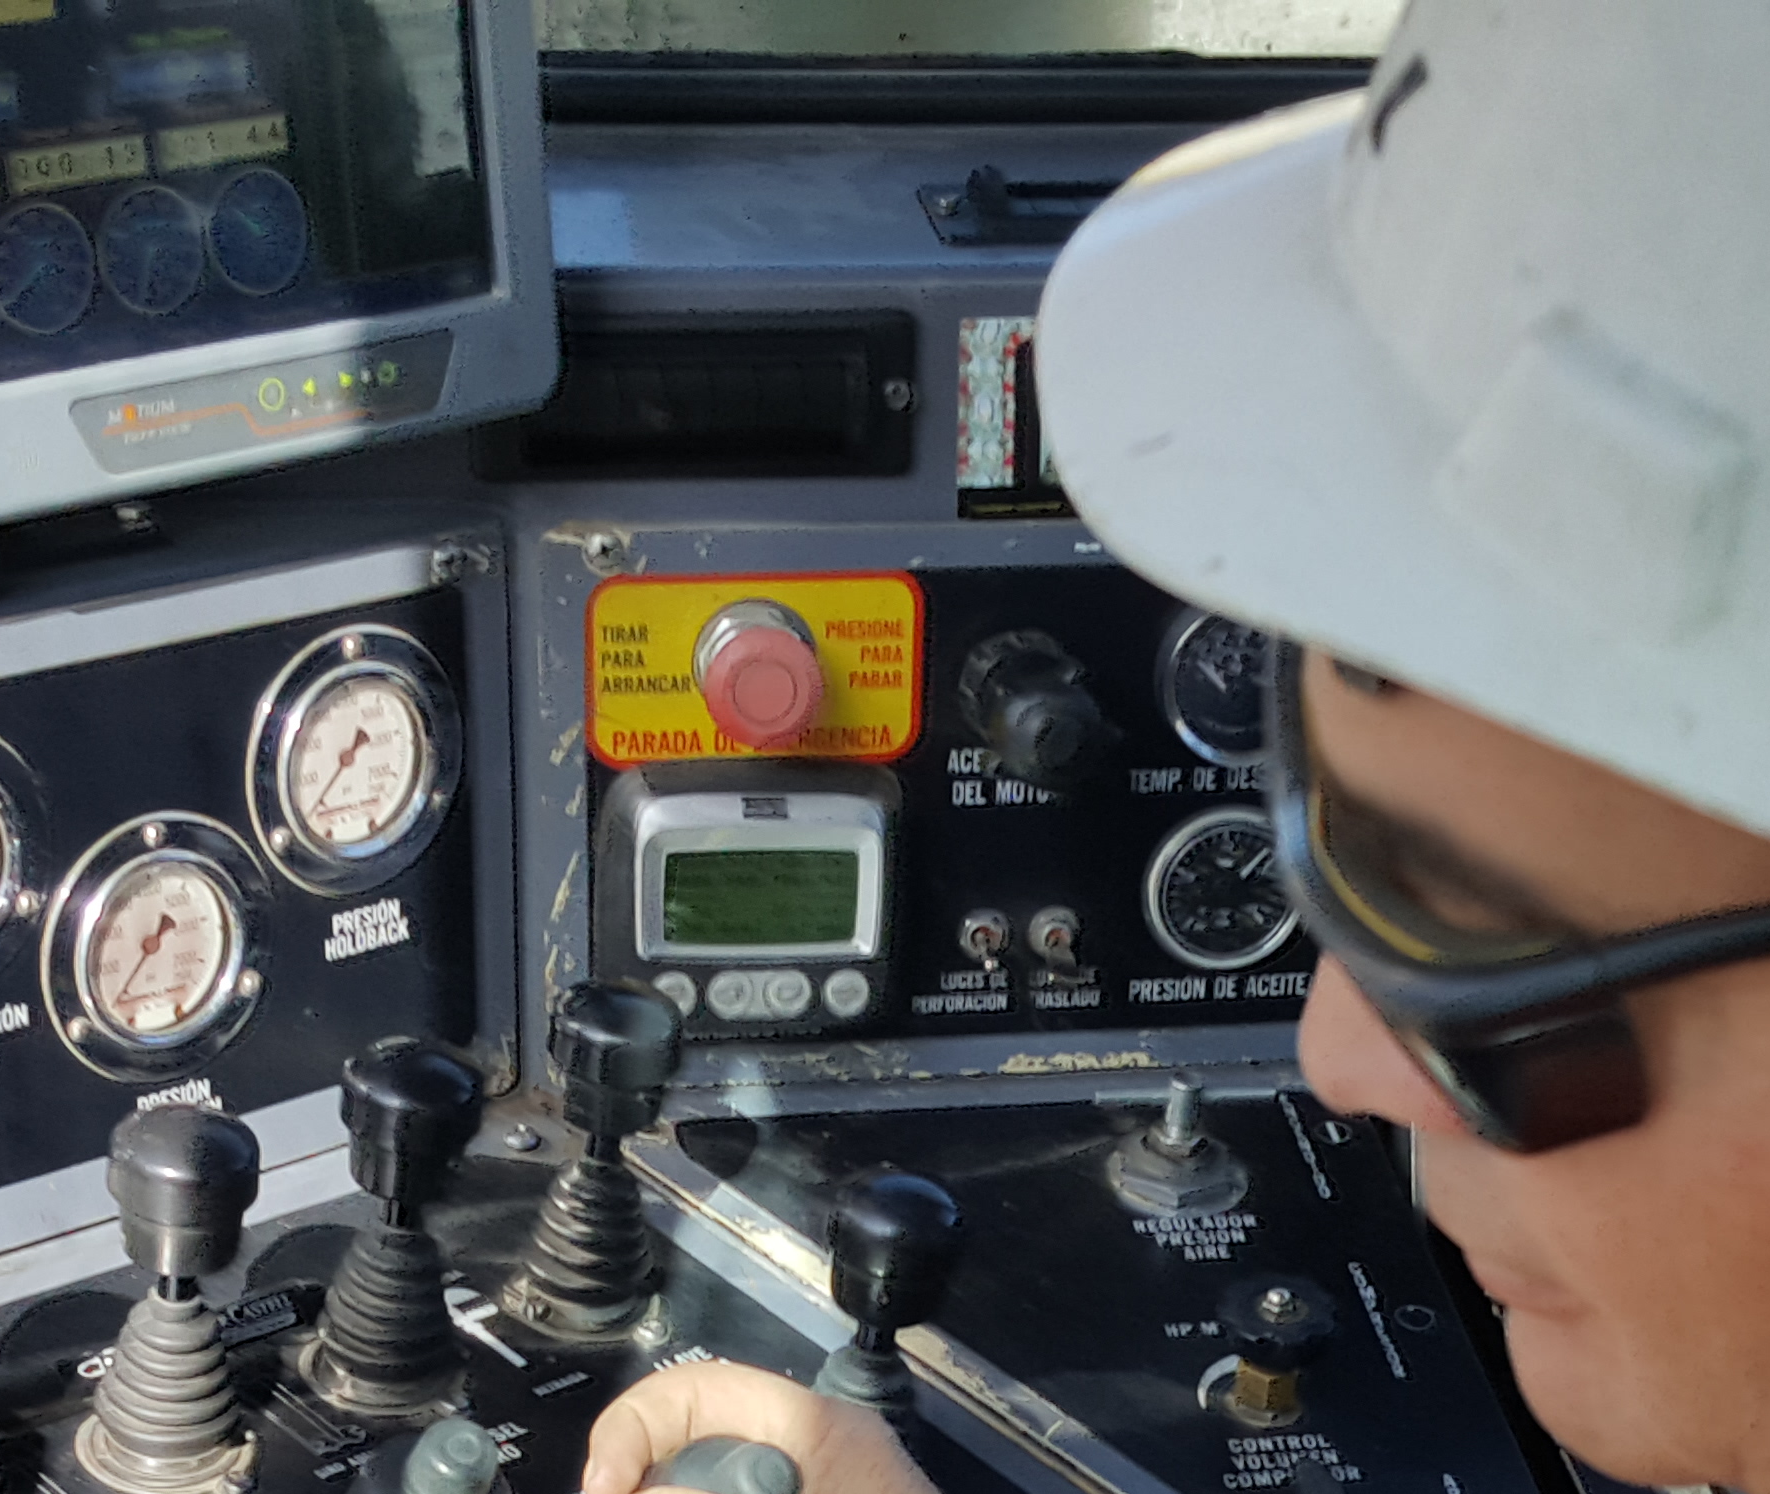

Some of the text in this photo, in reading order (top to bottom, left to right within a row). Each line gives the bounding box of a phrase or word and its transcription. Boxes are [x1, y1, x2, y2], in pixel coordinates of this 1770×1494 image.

[601, 624, 649, 643] TIRAR
[825, 620, 904, 639] PRESIONE
[601, 650, 646, 668] PARA
[860, 644, 904, 663] PARA
[601, 672, 692, 693] ARRANCAR
[849, 669, 903, 688] PARAR
[612, 729, 702, 755] PARADA
[1193, 766, 1216, 791] DE
[951, 779, 1057, 806] DEL MOTO
[324, 916, 410, 962] HOLDBACK
[940, 971, 985, 990] LUCES
[1213, 975, 1239, 999] DE
[1246, 971, 1309, 998] ACEITE
[1132, 1213, 1258, 1234] REGULADOR
[1184, 1244, 1231, 1261] AIRE
[1227, 1433, 1331, 1454] CONTROL
[1223, 1464, 1363, 1489] COMPOR
